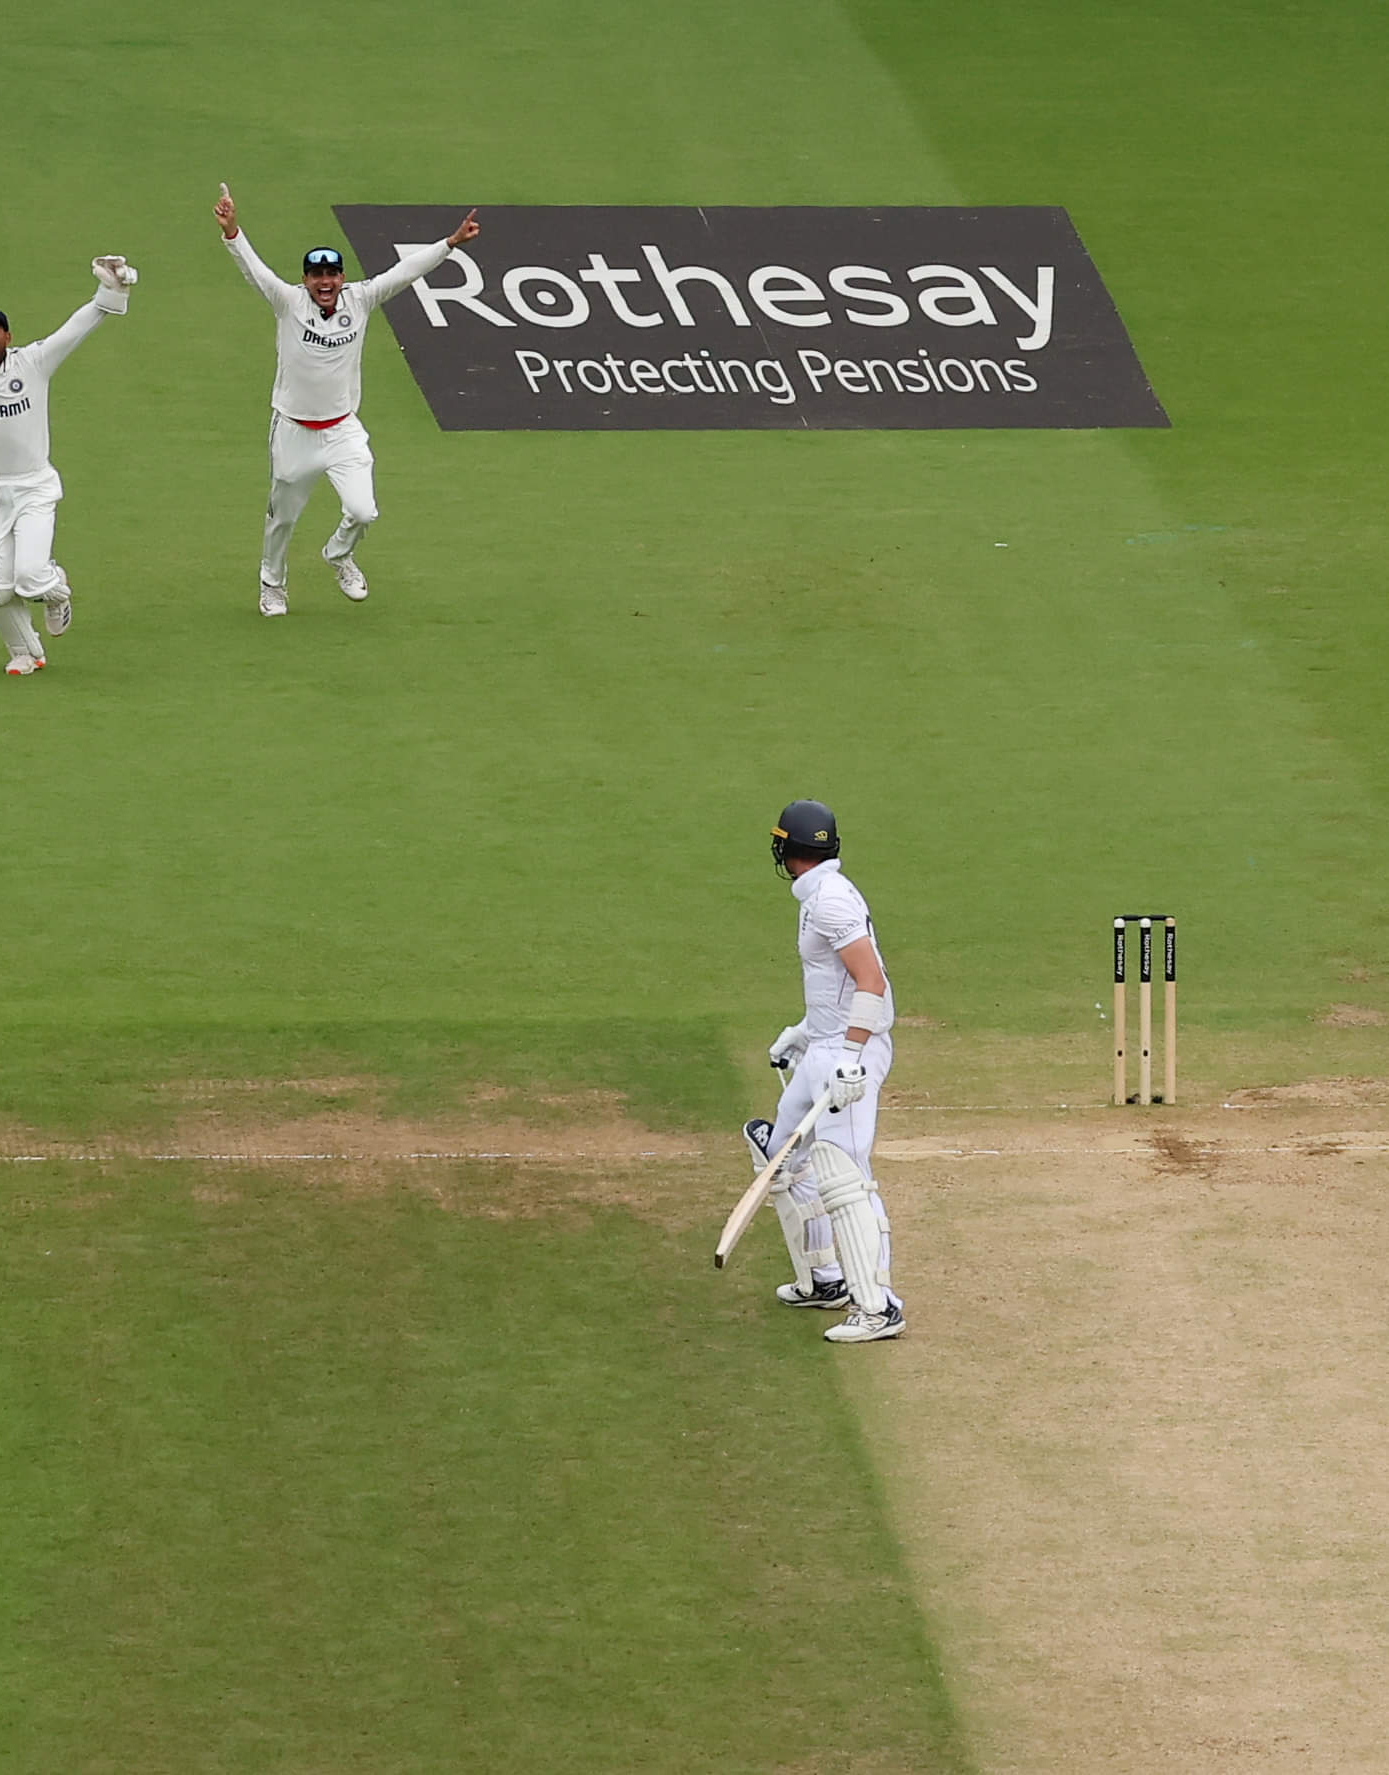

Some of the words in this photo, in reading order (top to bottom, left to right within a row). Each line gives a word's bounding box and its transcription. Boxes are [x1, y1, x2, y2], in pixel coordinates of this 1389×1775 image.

[393, 243, 1054, 351] Rothesay
[514, 350, 797, 403] Protecting
[797, 349, 1038, 394] Pensions
